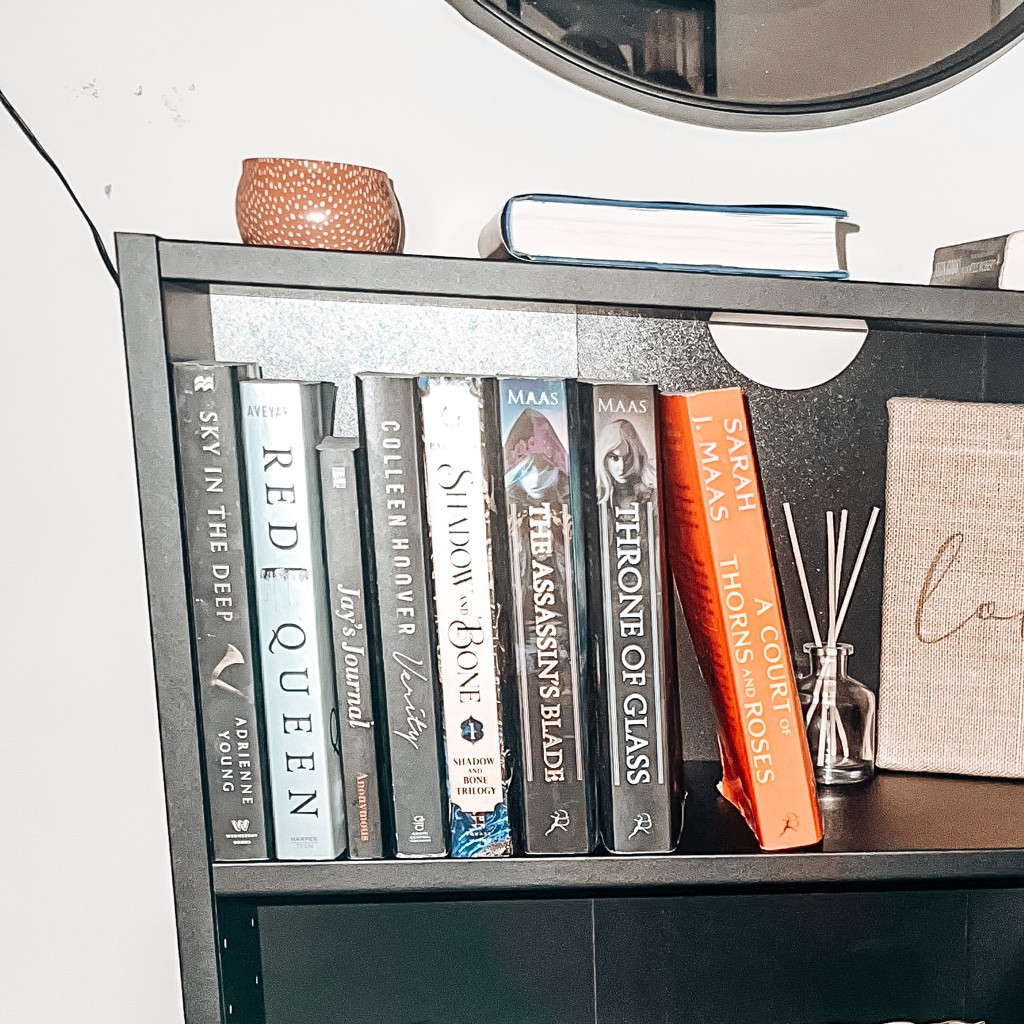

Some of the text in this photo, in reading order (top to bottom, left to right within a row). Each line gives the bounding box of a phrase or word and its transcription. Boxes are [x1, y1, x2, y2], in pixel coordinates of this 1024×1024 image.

[507, 389, 558, 407] MAAS
[597, 397, 648, 414] MAAS
[692, 415, 729, 523] J. MAAS
[724, 418, 757, 512] SARAH
[200, 411, 232, 622] SKY IN THE DEEP
[381, 420, 416, 635] COLLEEN HOOVER
[437, 464, 474, 588] SHADOW
[263, 446, 319, 819] RED QUEEN
[335, 583, 375, 730] Jay's Journal
[447, 617, 485, 704] BONE
[528, 503, 565, 784] THE ASSASSIN'S BLADE
[614, 502, 651, 786] THRONE OF GLASS
[719, 553, 775, 785] THORNS AND ROSES
[754, 597, 792, 737] A COURT OF
[393, 650, 428, 750] Verity
[217, 730, 235, 793] YOUNG
[234, 717, 254, 805] ADRIENNE
[355, 772, 370, 842] Anonymous
[453, 757, 495, 766] SHADOW
[456, 787, 496, 795] TRILOGY
[463, 776, 488, 785] BONE
